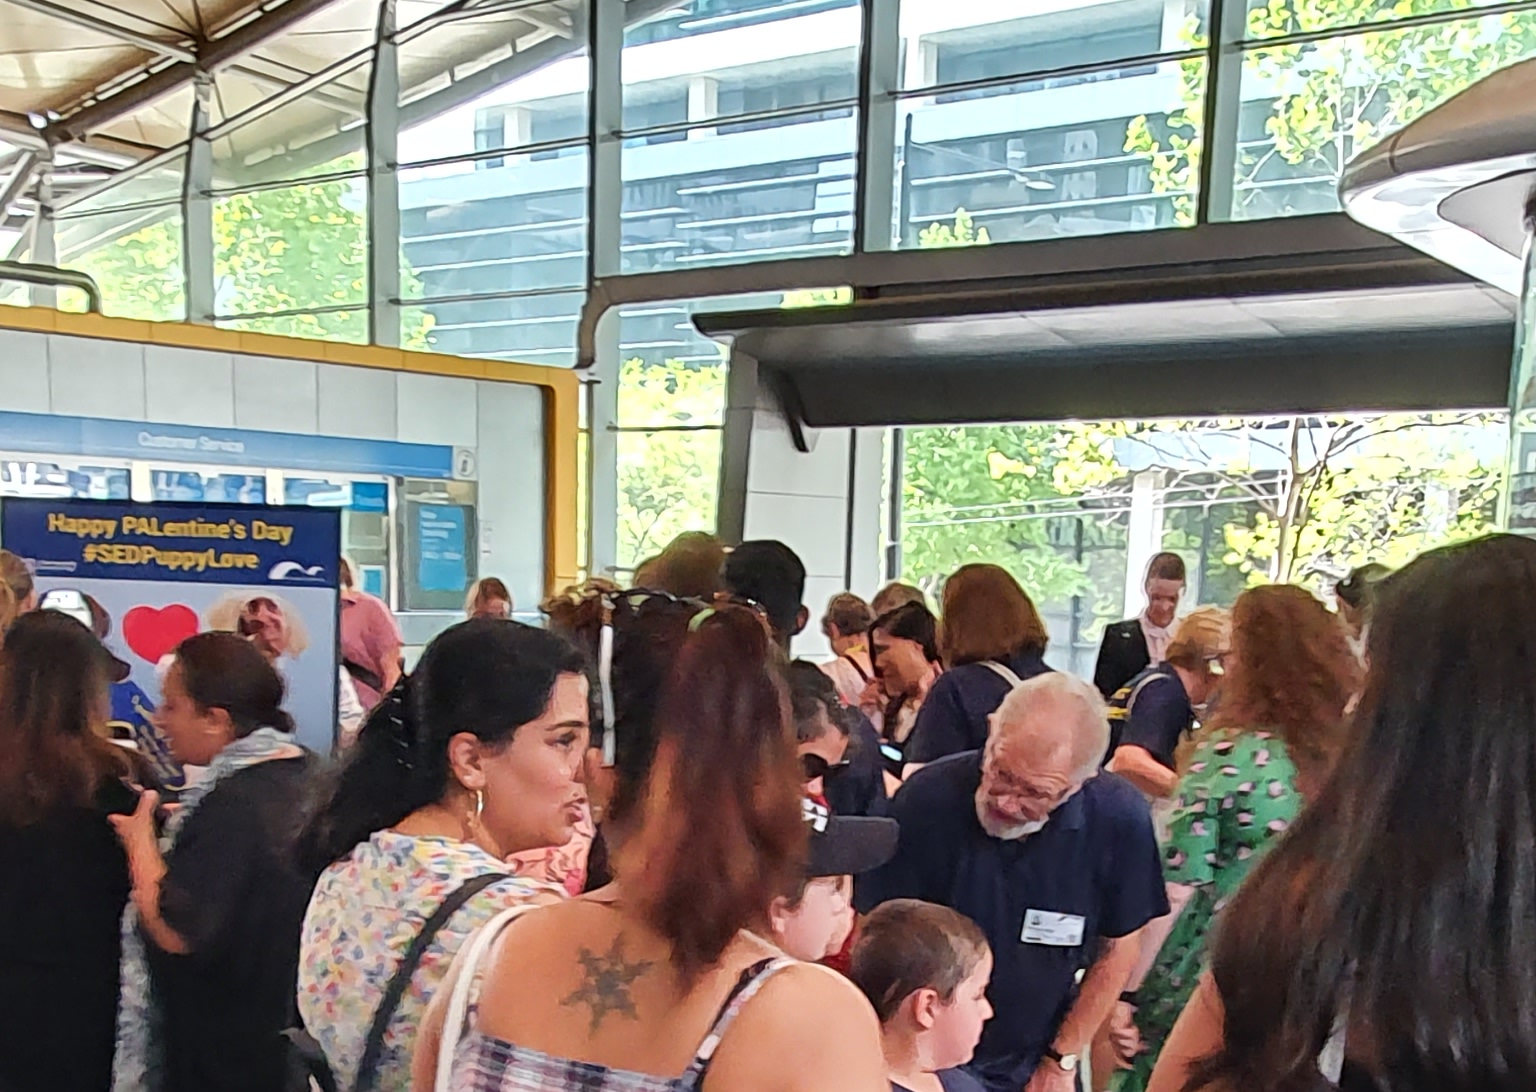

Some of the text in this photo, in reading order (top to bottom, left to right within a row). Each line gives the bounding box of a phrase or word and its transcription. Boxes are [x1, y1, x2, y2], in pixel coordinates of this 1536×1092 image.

[199, 436, 245, 454] Service
[47, 513, 293, 546] Happy PALentine's Day
[83, 543, 260, 573] #SEDPuppyLove
